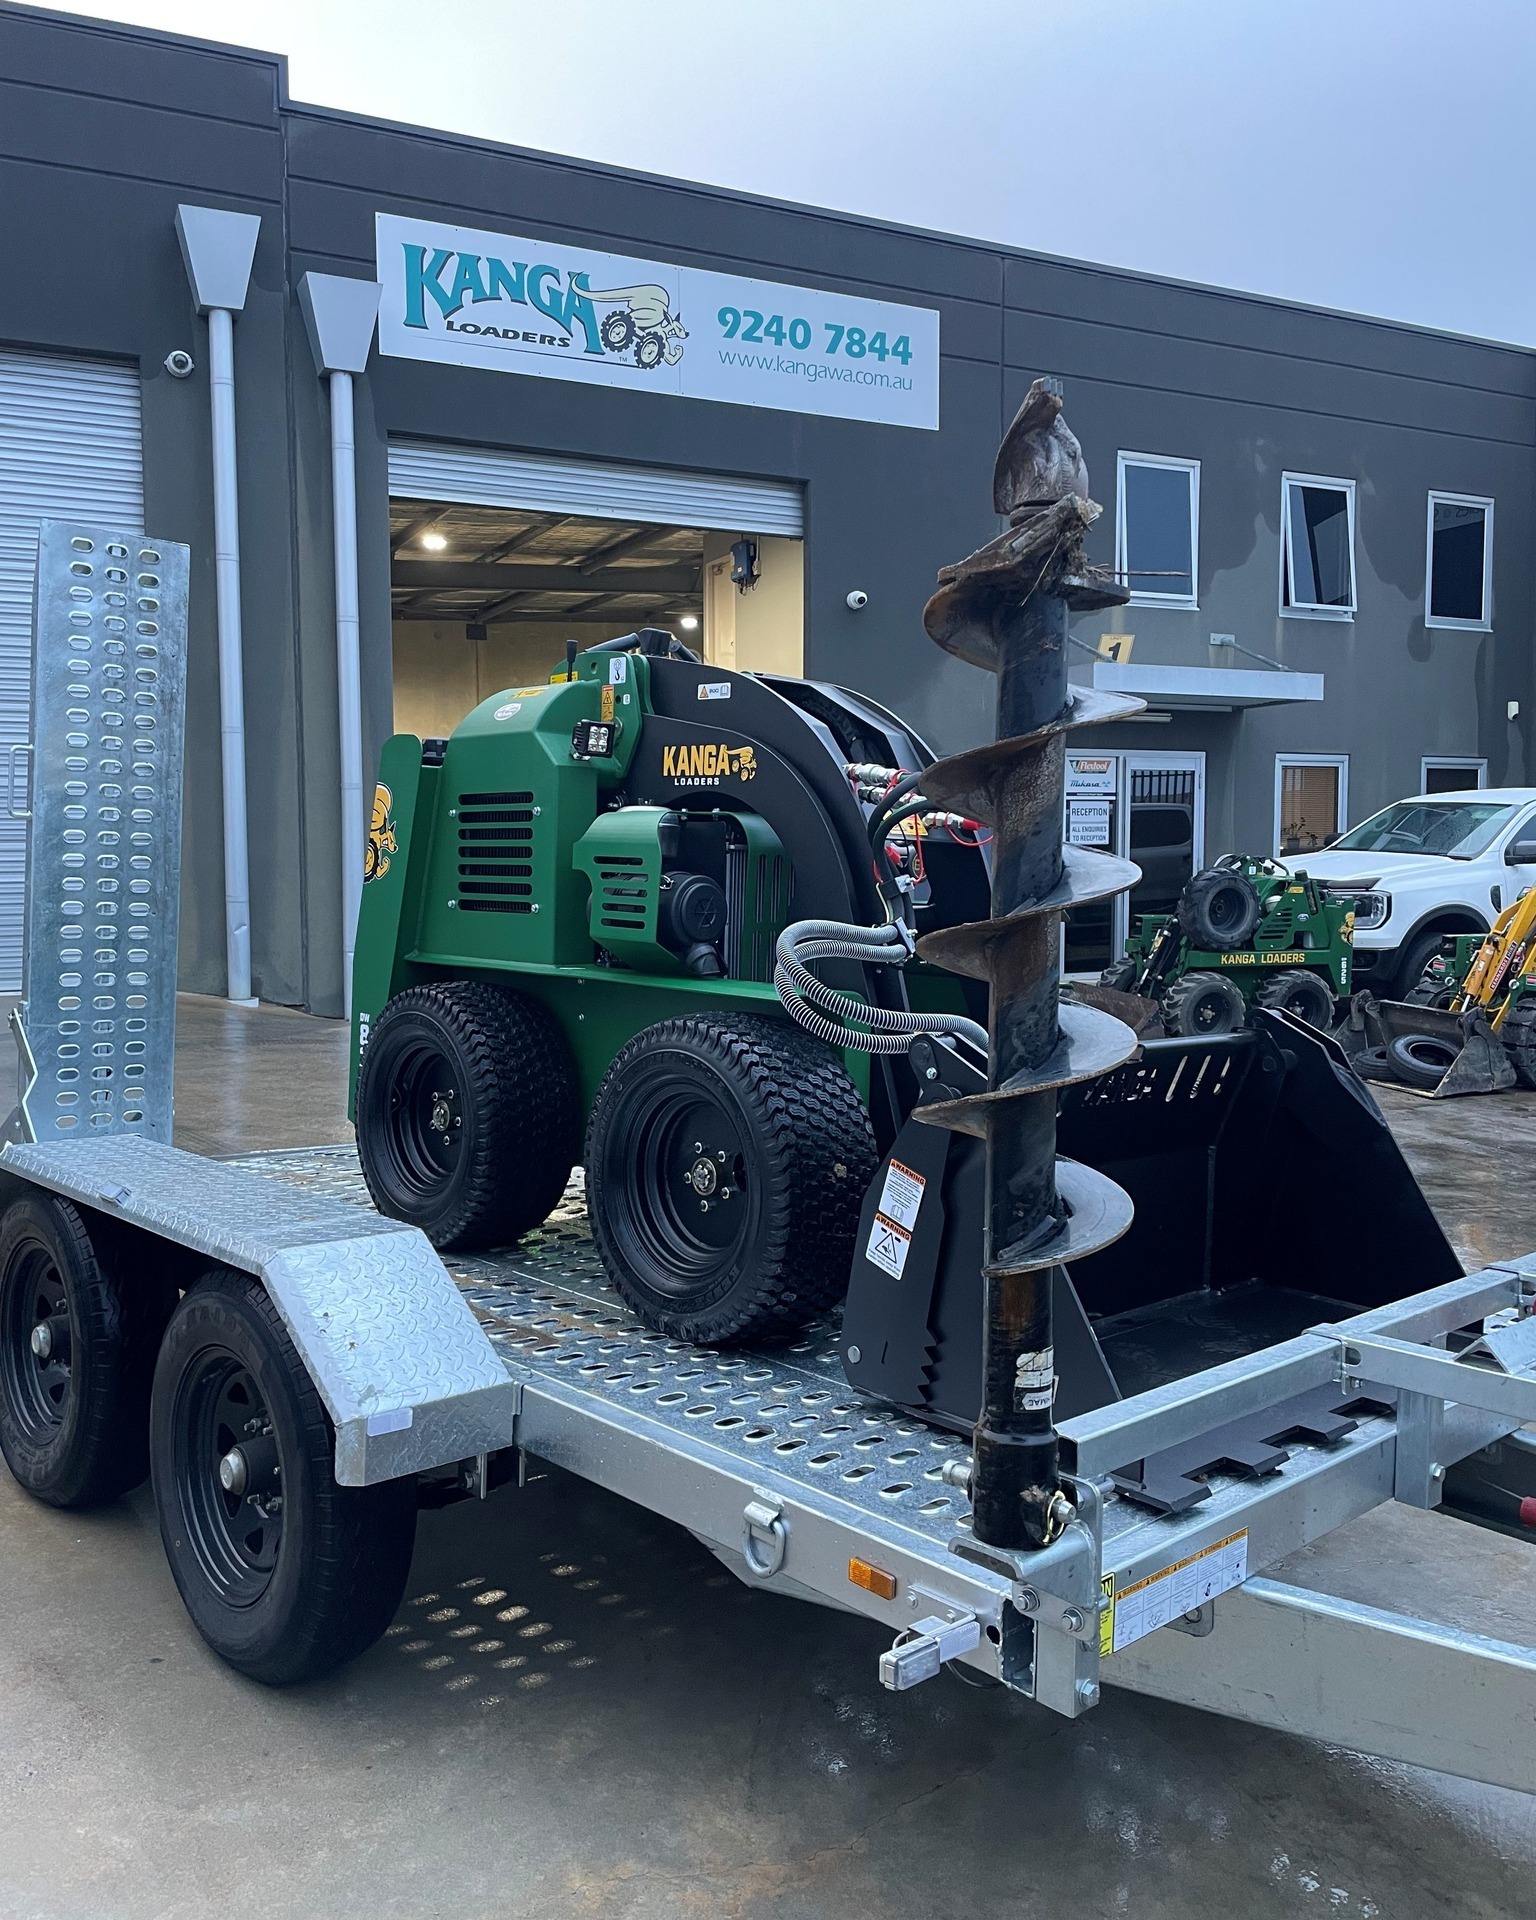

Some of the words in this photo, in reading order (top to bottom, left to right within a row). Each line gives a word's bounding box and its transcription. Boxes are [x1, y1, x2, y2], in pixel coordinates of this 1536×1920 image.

[401, 243, 606, 355] KANGA
[446, 320, 571, 348] LOADERS
[717, 306, 811, 350] 9240
[824, 322, 913, 366] 7844
[718, 350, 913, 391] www.kangawa.com.au
[1108, 642, 1122, 661] 1
[663, 744, 730, 777] KANGA
[674, 777, 720, 786] LOADERS
[1071, 808, 1108, 817] RECEPTION
[1221, 954, 1256, 965] KANGA
[1261, 953, 1306, 964] LOADERS
[895, 1163, 925, 1185] WARNING
[881, 1217, 911, 1241] WARNING
